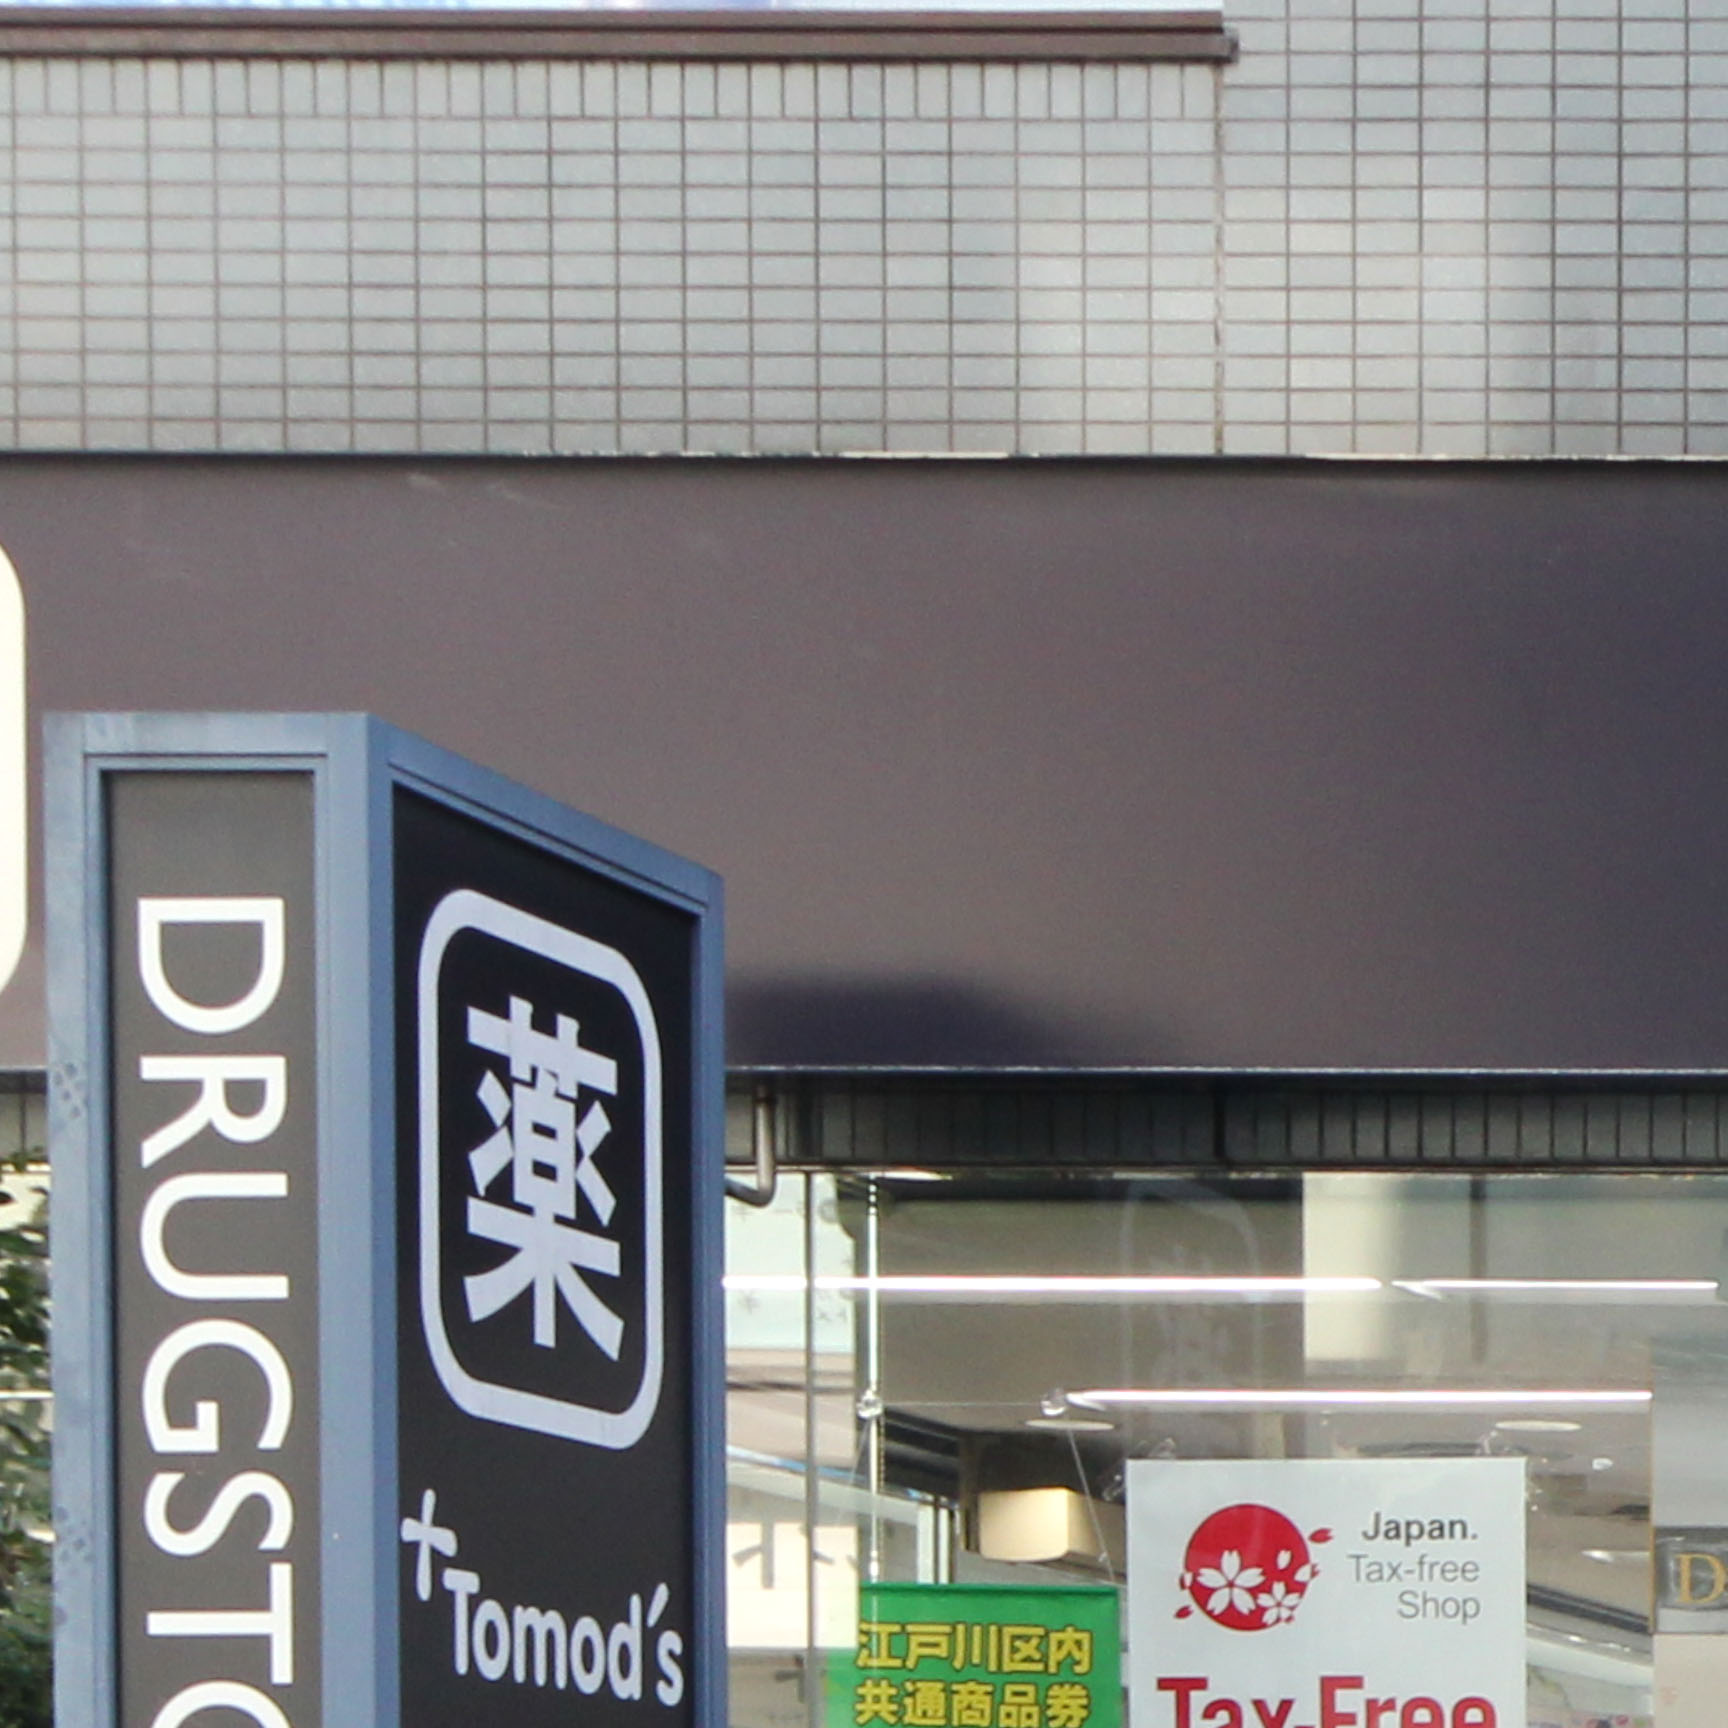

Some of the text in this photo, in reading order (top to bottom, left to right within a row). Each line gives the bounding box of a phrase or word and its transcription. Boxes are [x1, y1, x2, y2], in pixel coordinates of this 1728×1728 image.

[463, 995, 625, 1361] 薬
[1362, 1512, 1478, 1543] Japan.
[1347, 1554, 1480, 1584] Tax-free
[1397, 1590, 1480, 1623] Shop
[442, 1567, 684, 1707] Tomod's
[856, 1622, 1094, 1676] 江戸川区内
